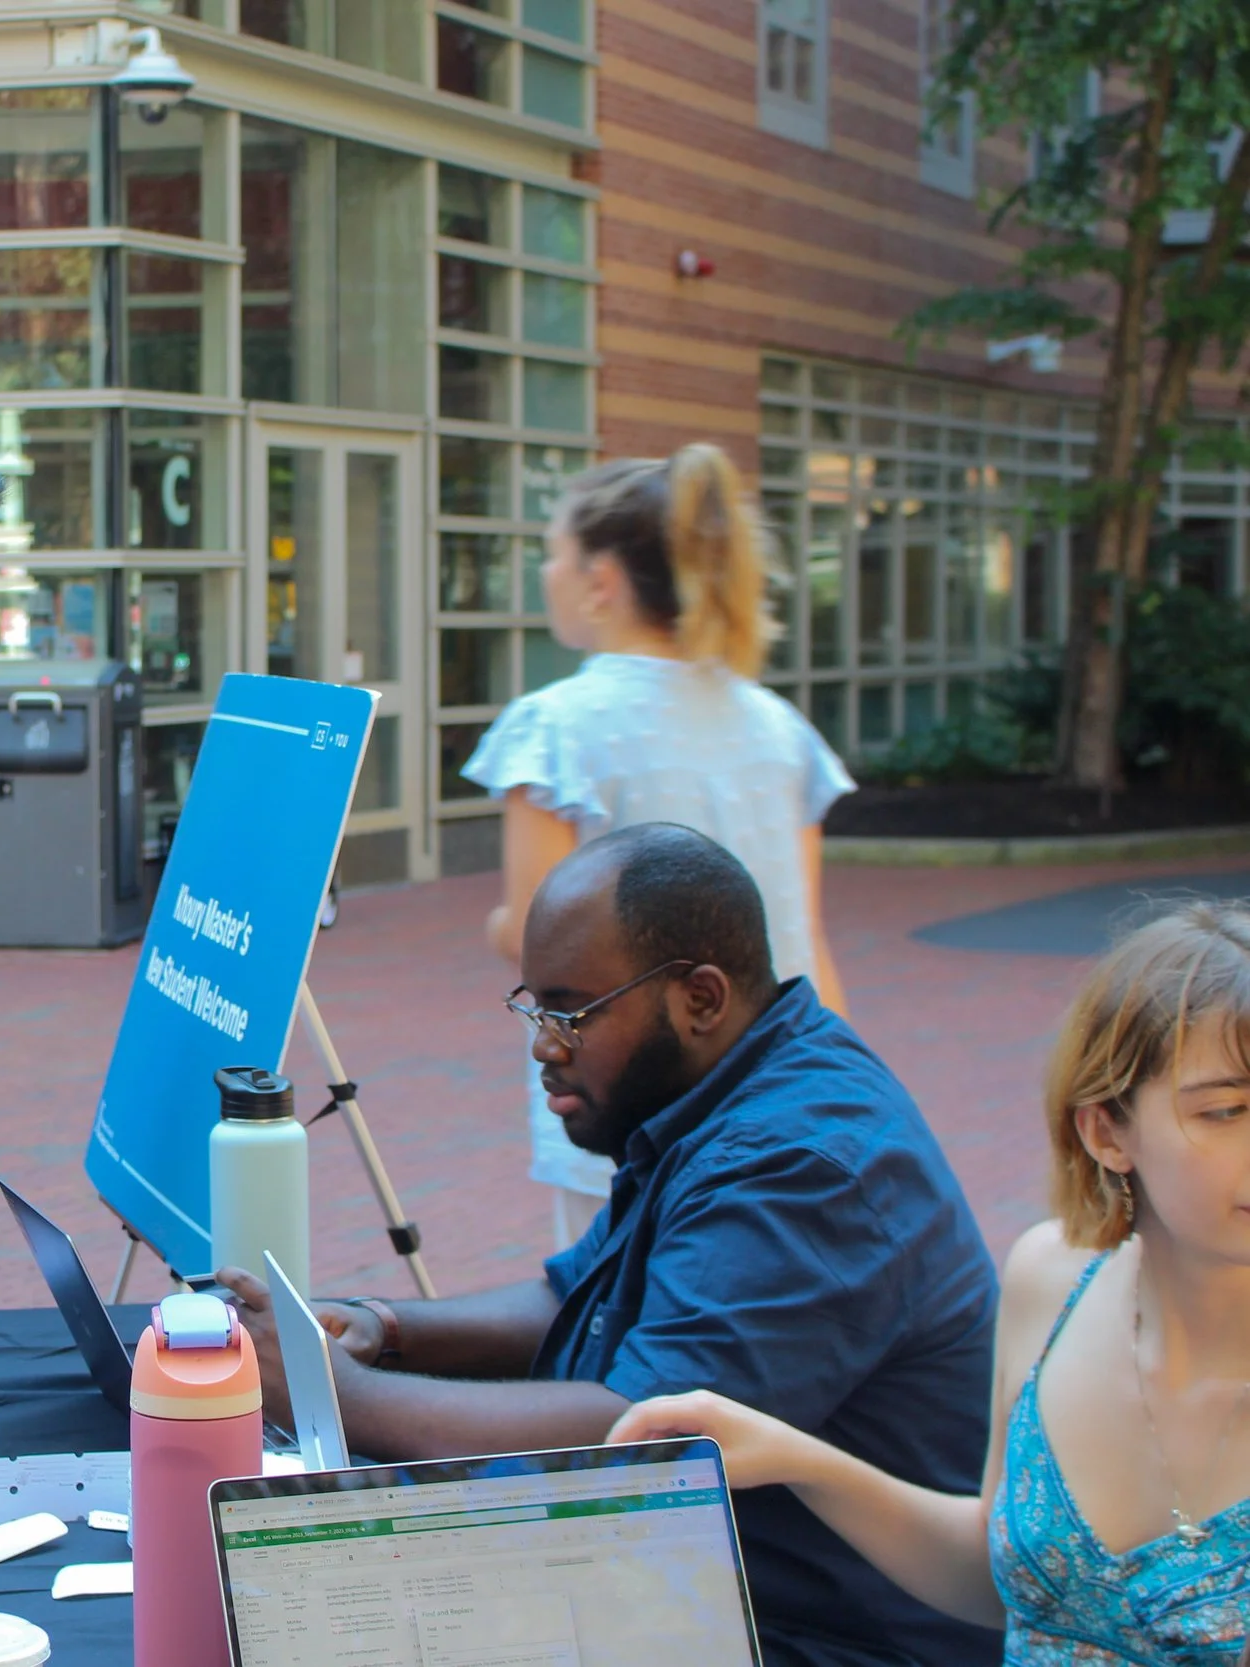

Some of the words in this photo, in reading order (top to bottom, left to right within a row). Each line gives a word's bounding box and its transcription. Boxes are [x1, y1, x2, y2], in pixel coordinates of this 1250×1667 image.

[161, 455, 190, 527] C
[335, 733, 350, 748] YOU
[173, 883, 207, 940] Khoury
[201, 898, 253, 956] Master's
[145, 946, 165, 988] New
[158, 955, 199, 1012] Student
[193, 976, 249, 1042] Welcome
[436, 1608, 449, 1616] and
